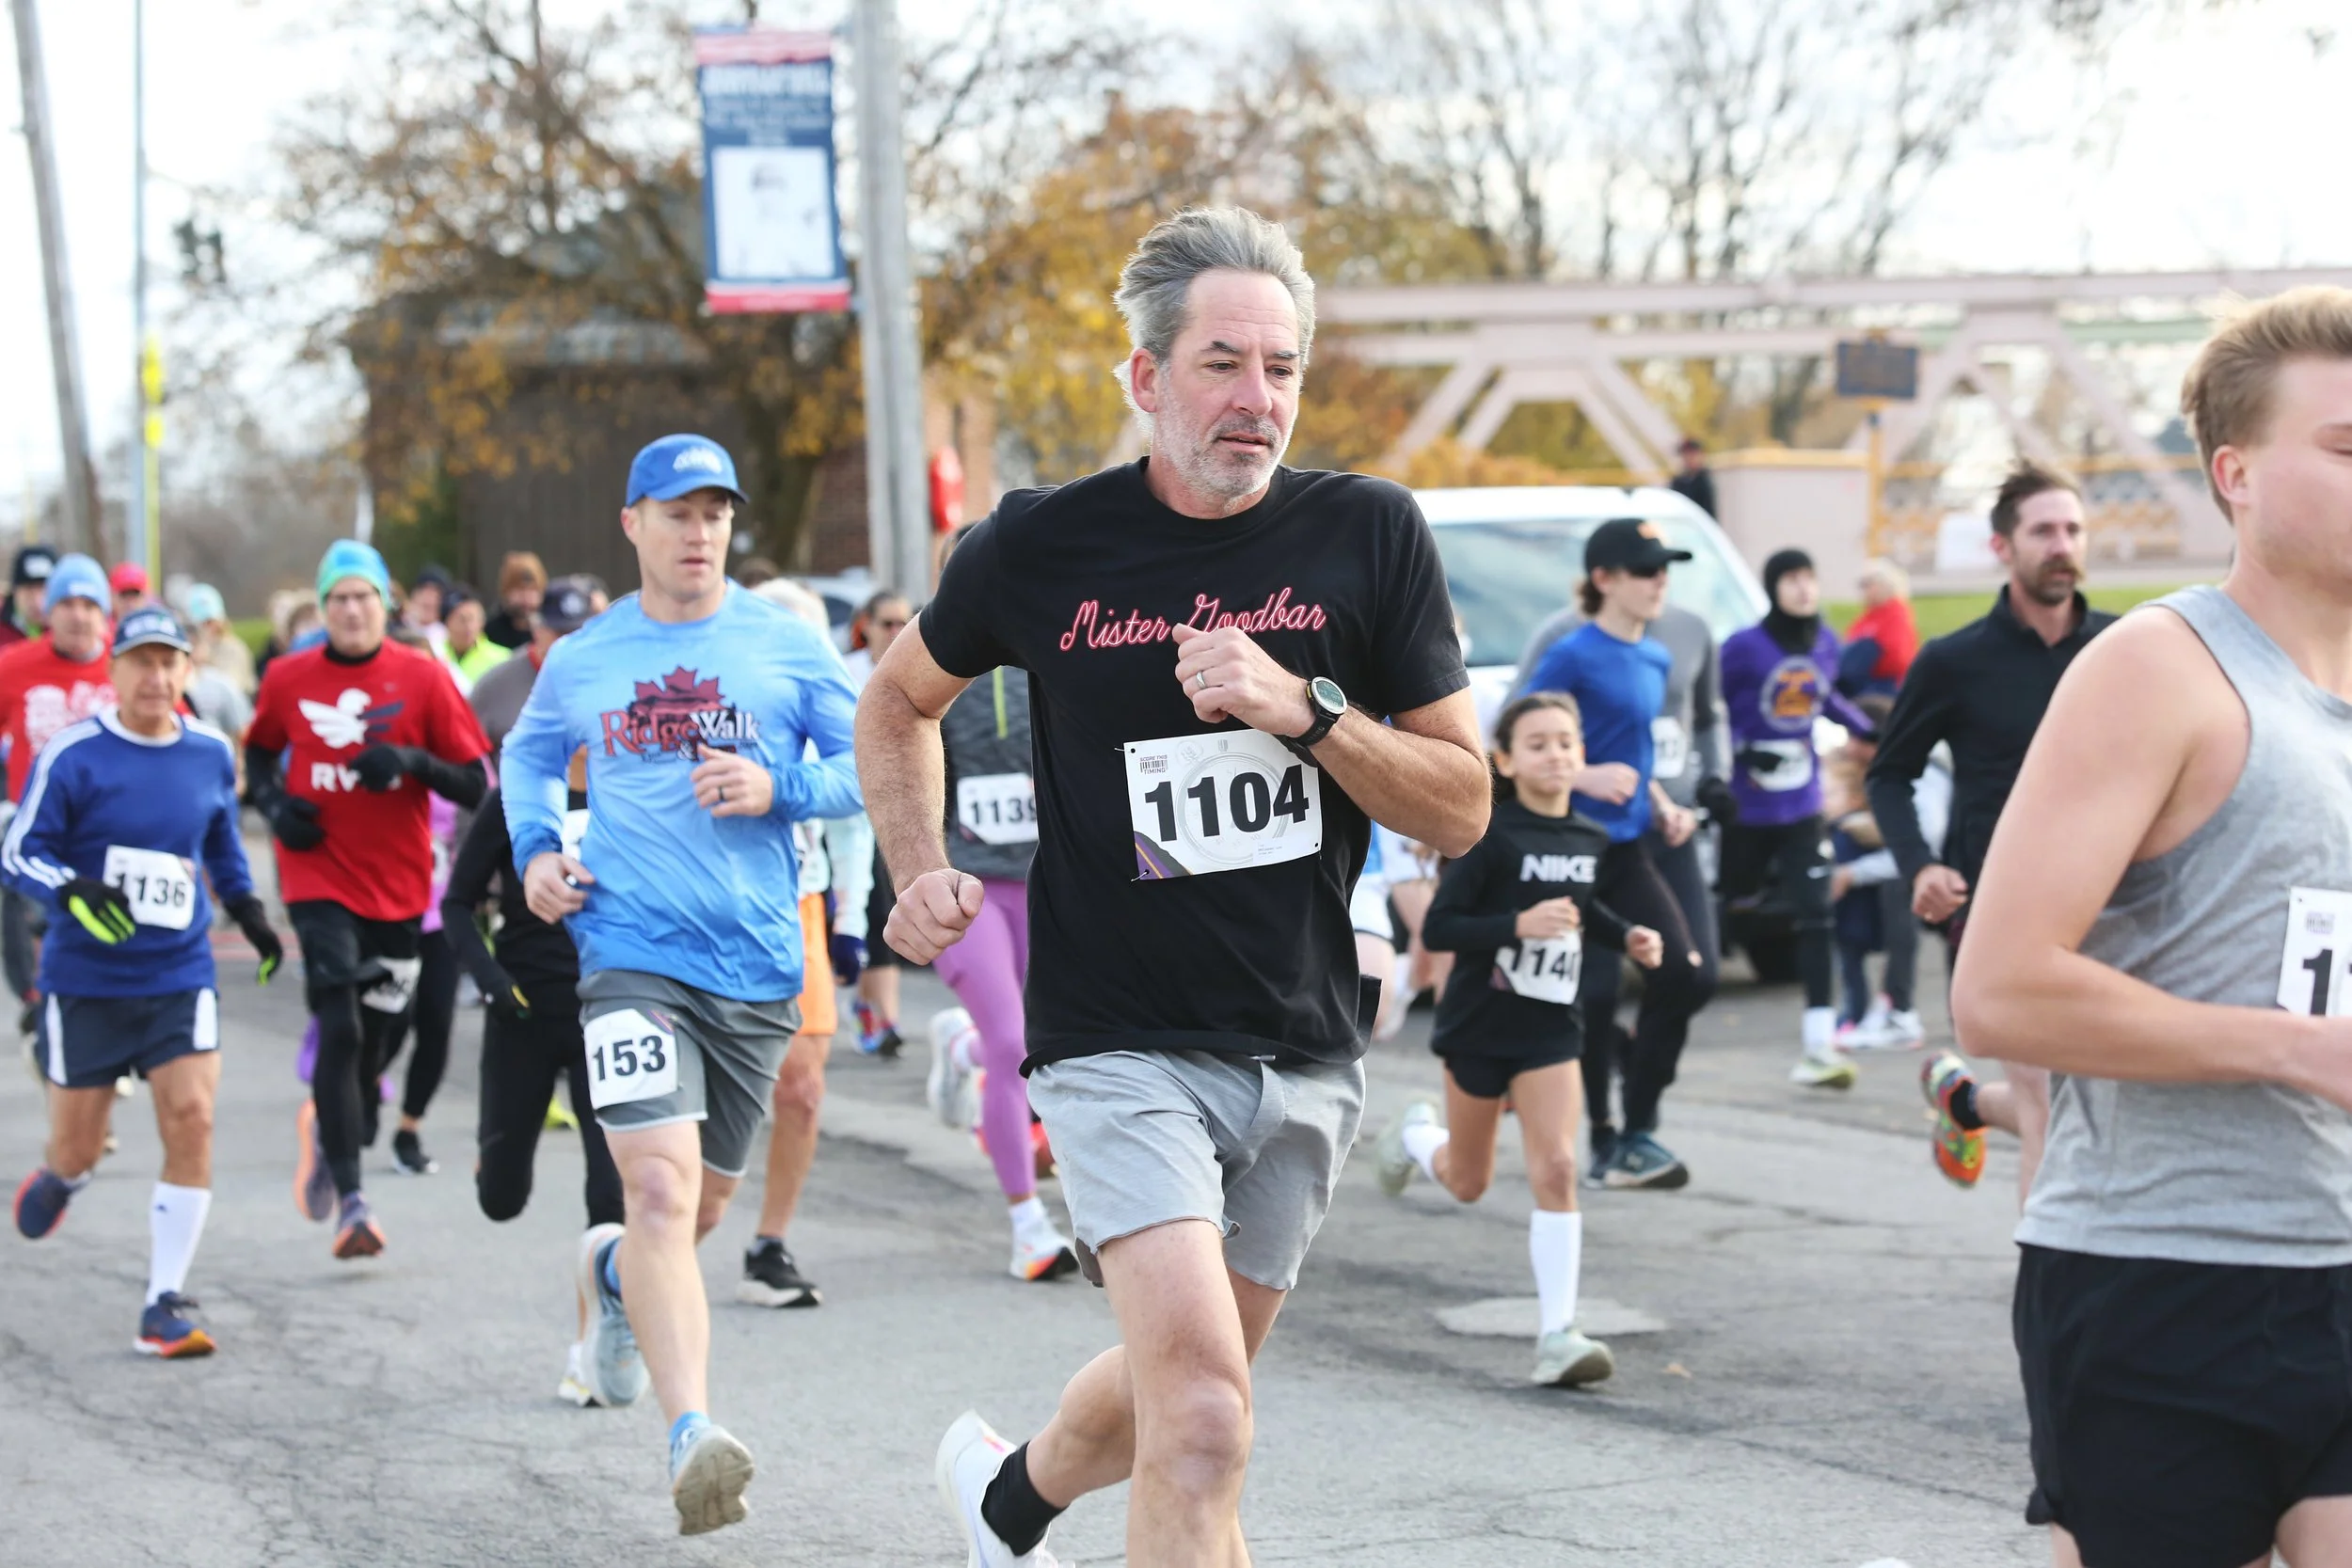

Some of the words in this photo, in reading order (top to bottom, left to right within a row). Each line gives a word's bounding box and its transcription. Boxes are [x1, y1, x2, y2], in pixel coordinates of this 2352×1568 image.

[1059, 599, 1171, 651] Mister
[1185, 586, 1327, 634] Goodbar
[1144, 767, 1167, 775] TIMING
[1144, 764, 1310, 842] 1104
[1519, 853, 1597, 883] NIKE
[2302, 948, 2352, 1016] 1
[593, 1035, 666, 1082] 153
